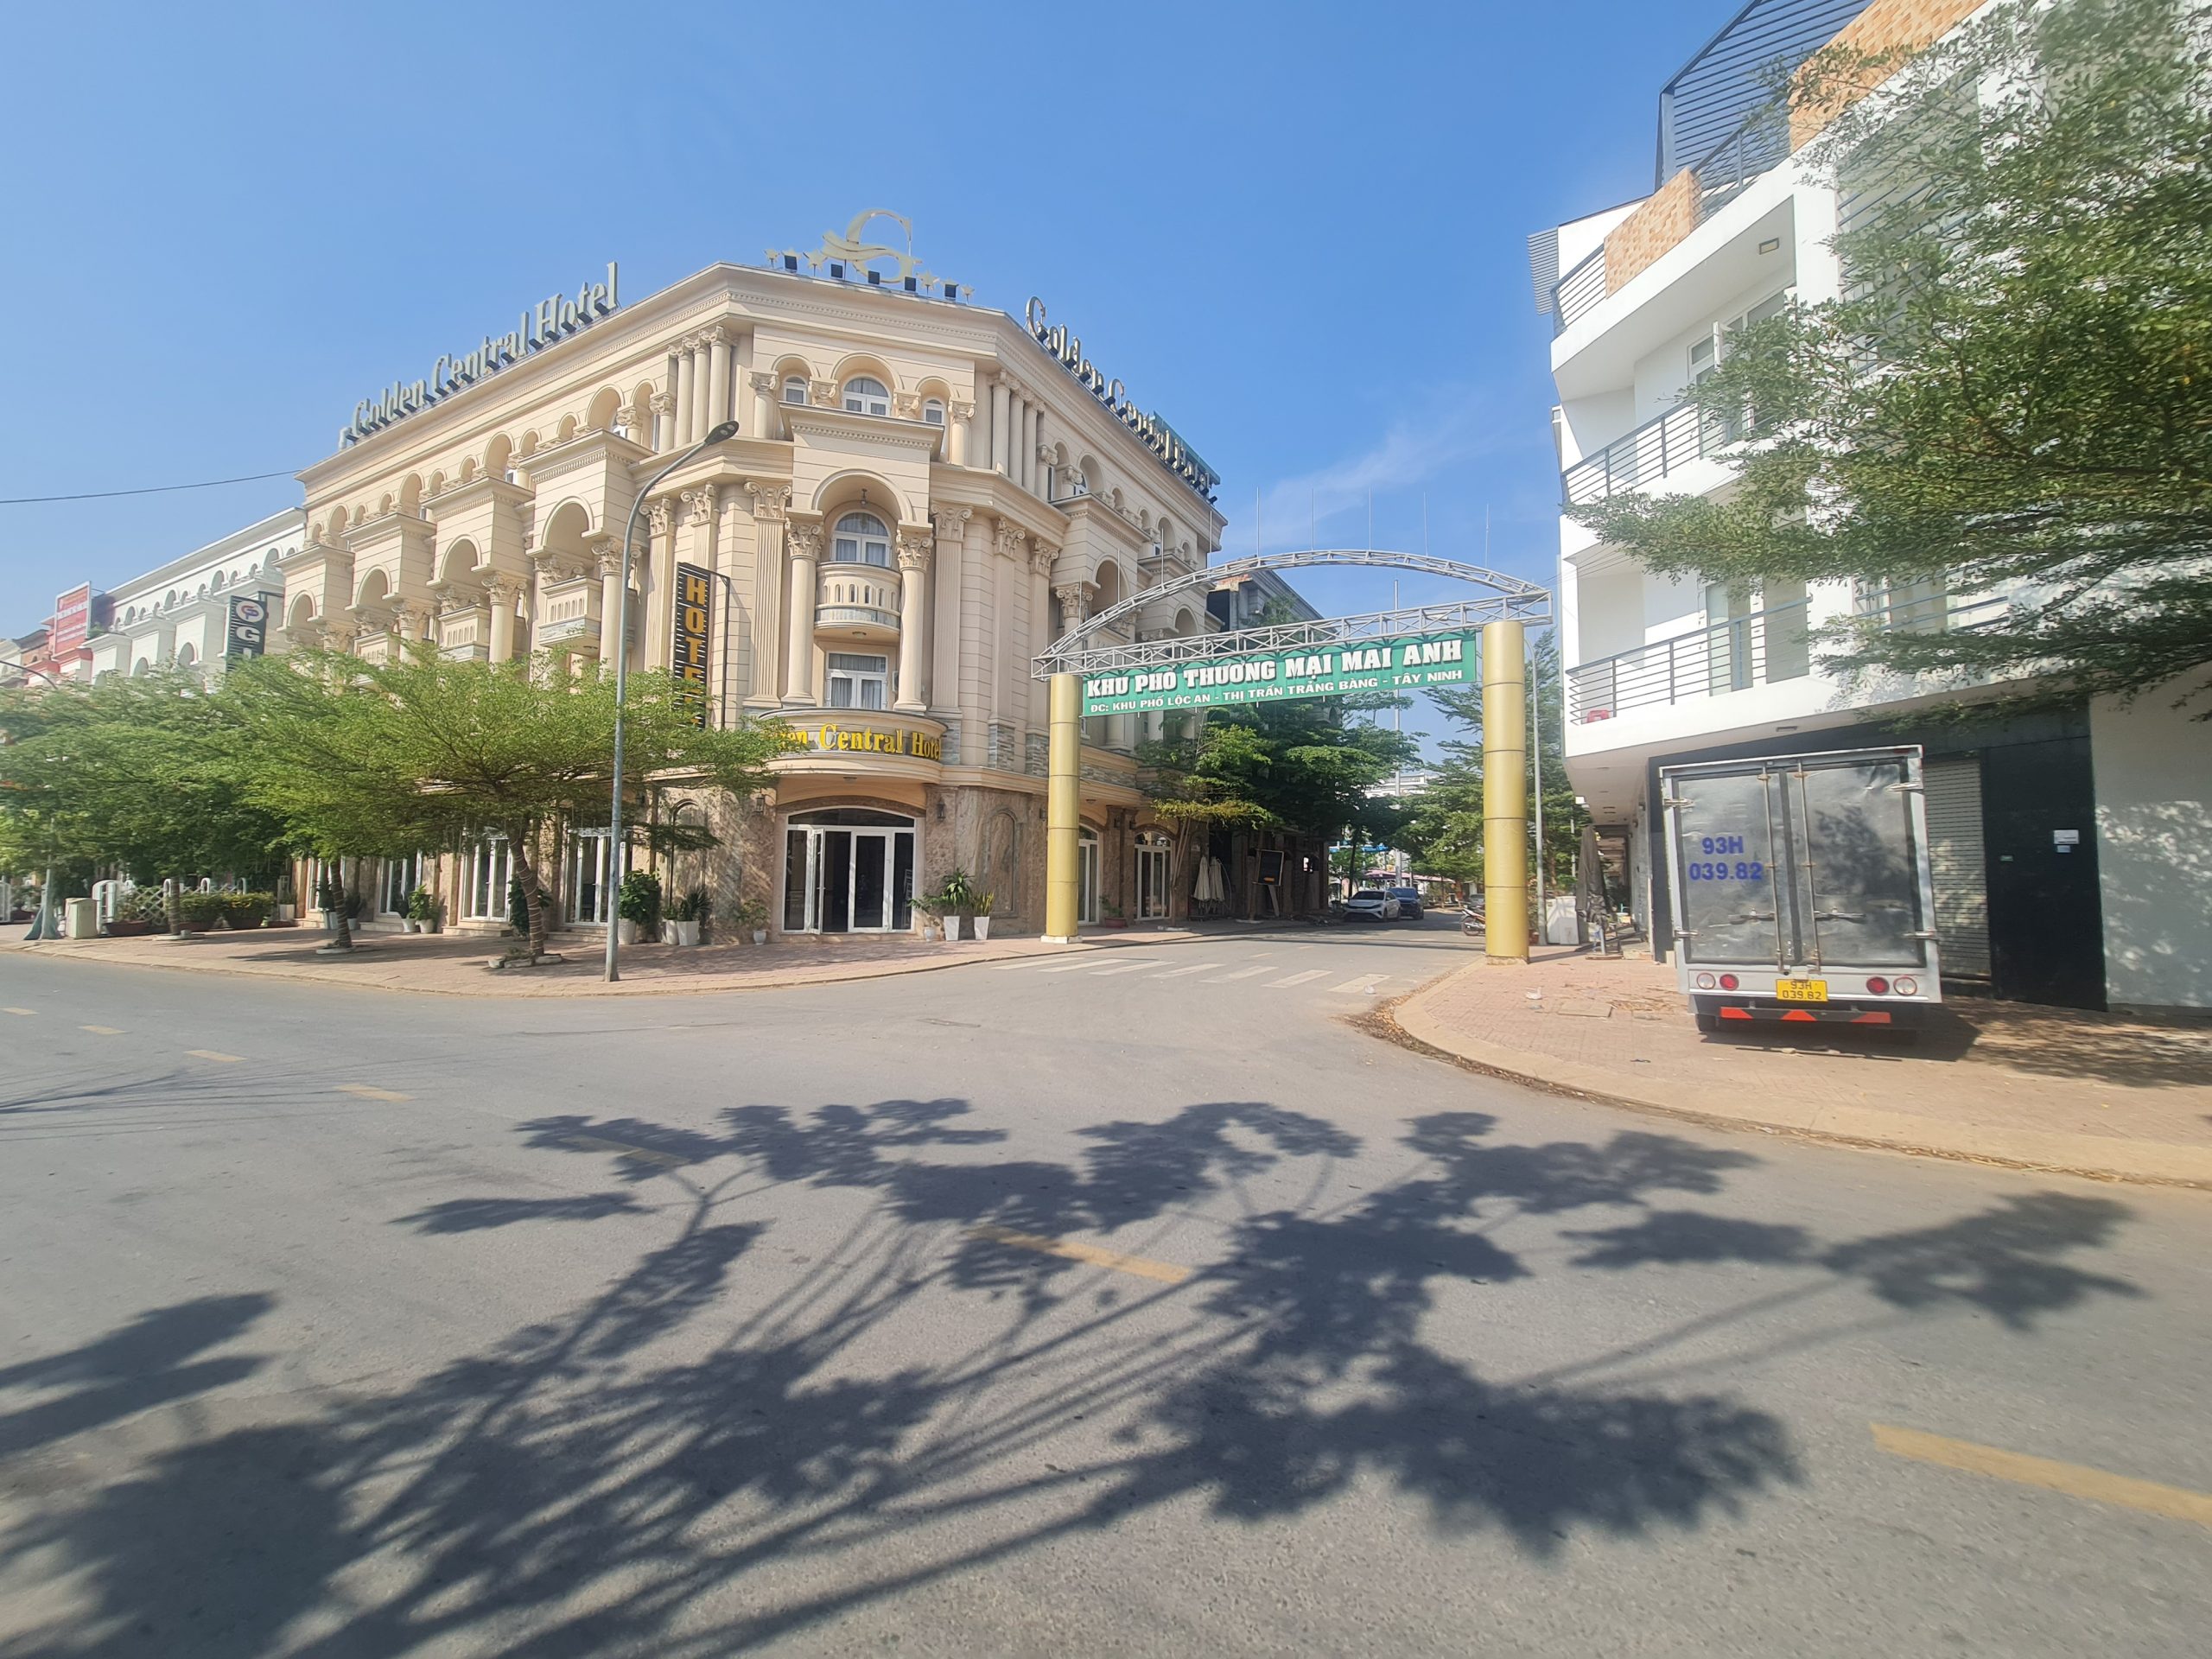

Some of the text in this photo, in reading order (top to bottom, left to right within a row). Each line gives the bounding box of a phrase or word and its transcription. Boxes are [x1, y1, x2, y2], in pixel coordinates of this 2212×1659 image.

[352, 261, 619, 437] Golden Central Hotel
[1026, 296, 1105, 401] Golden
[1087, 676, 1129, 697] KHU
[1183, 659, 1276, 688] THƯƠNG
[1285, 653, 1332, 679] MẠI
[1341, 647, 1392, 672] MAI
[1402, 639, 1463, 665] ANH
[1090, 703, 1109, 713] ĐC:
[1112, 701, 1136, 711] KHU
[1140, 694, 1165, 708] PHỐ
[1167, 695, 1192, 707] LỘC
[1193, 694, 1211, 703] AN
[1223, 691, 1244, 702] THỊ
[1248, 683, 1283, 699] TRẤN
[1287, 681, 1334, 695] TRẢNG
[1339, 677, 1378, 690] BÀNG
[1392, 672, 1422, 685] TÂY
[1427, 670, 1463, 682] NINH
[820, 722, 903, 754] Central
[911, 732, 943, 761] Hotel
[1701, 836, 1744, 855] 93H
[1689, 861, 1763, 881] 039.82
[1782, 989, 1822, 1001] 039.82
[1789, 981, 1813, 990] 93H
